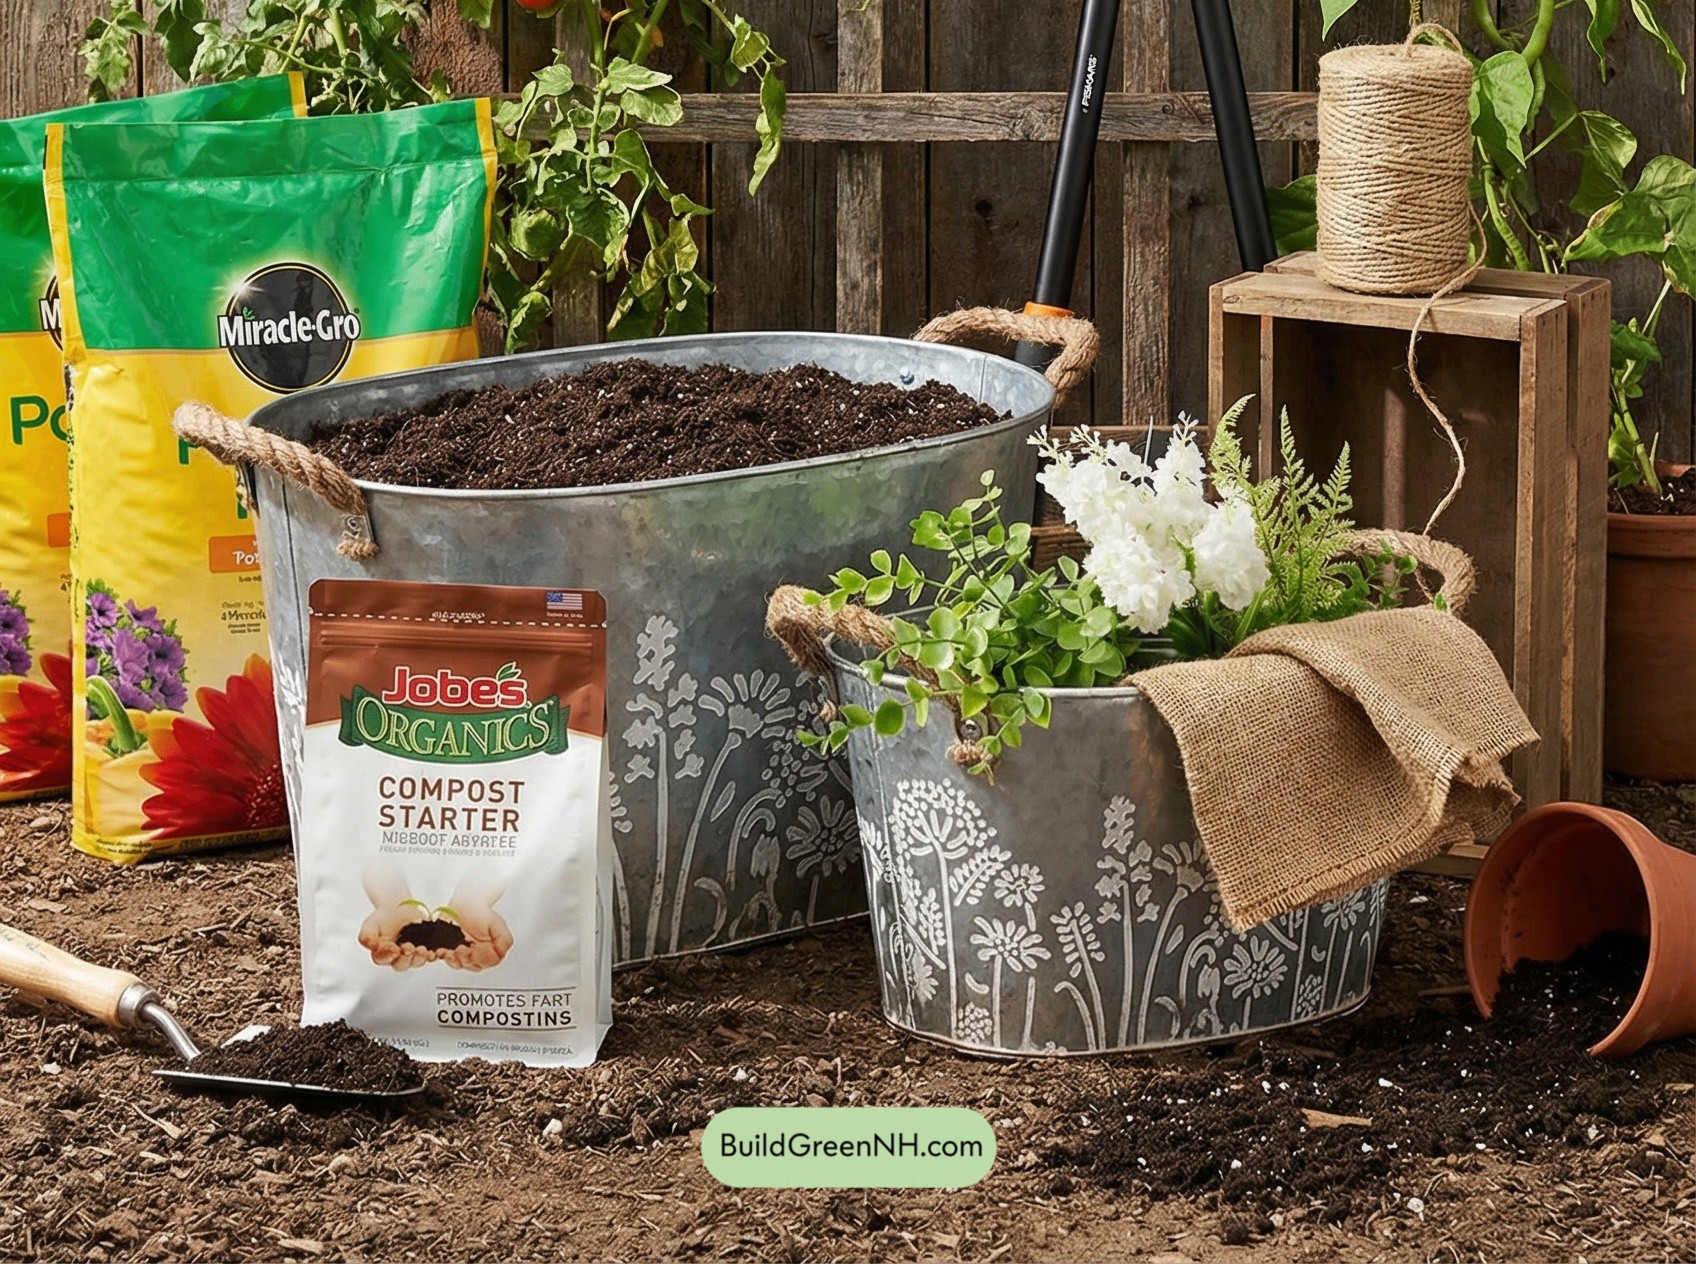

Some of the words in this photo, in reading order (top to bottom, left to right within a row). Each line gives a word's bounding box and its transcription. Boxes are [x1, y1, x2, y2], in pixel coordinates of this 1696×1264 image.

[357, 697, 551, 756] ORGANICS
[379, 776, 525, 804] COMPOST
[378, 804, 520, 833] STARTER
[437, 992, 526, 1008] PROMOTES
[532, 993, 572, 1007] FART
[437, 1009, 572, 1027] COMPOSTINS
